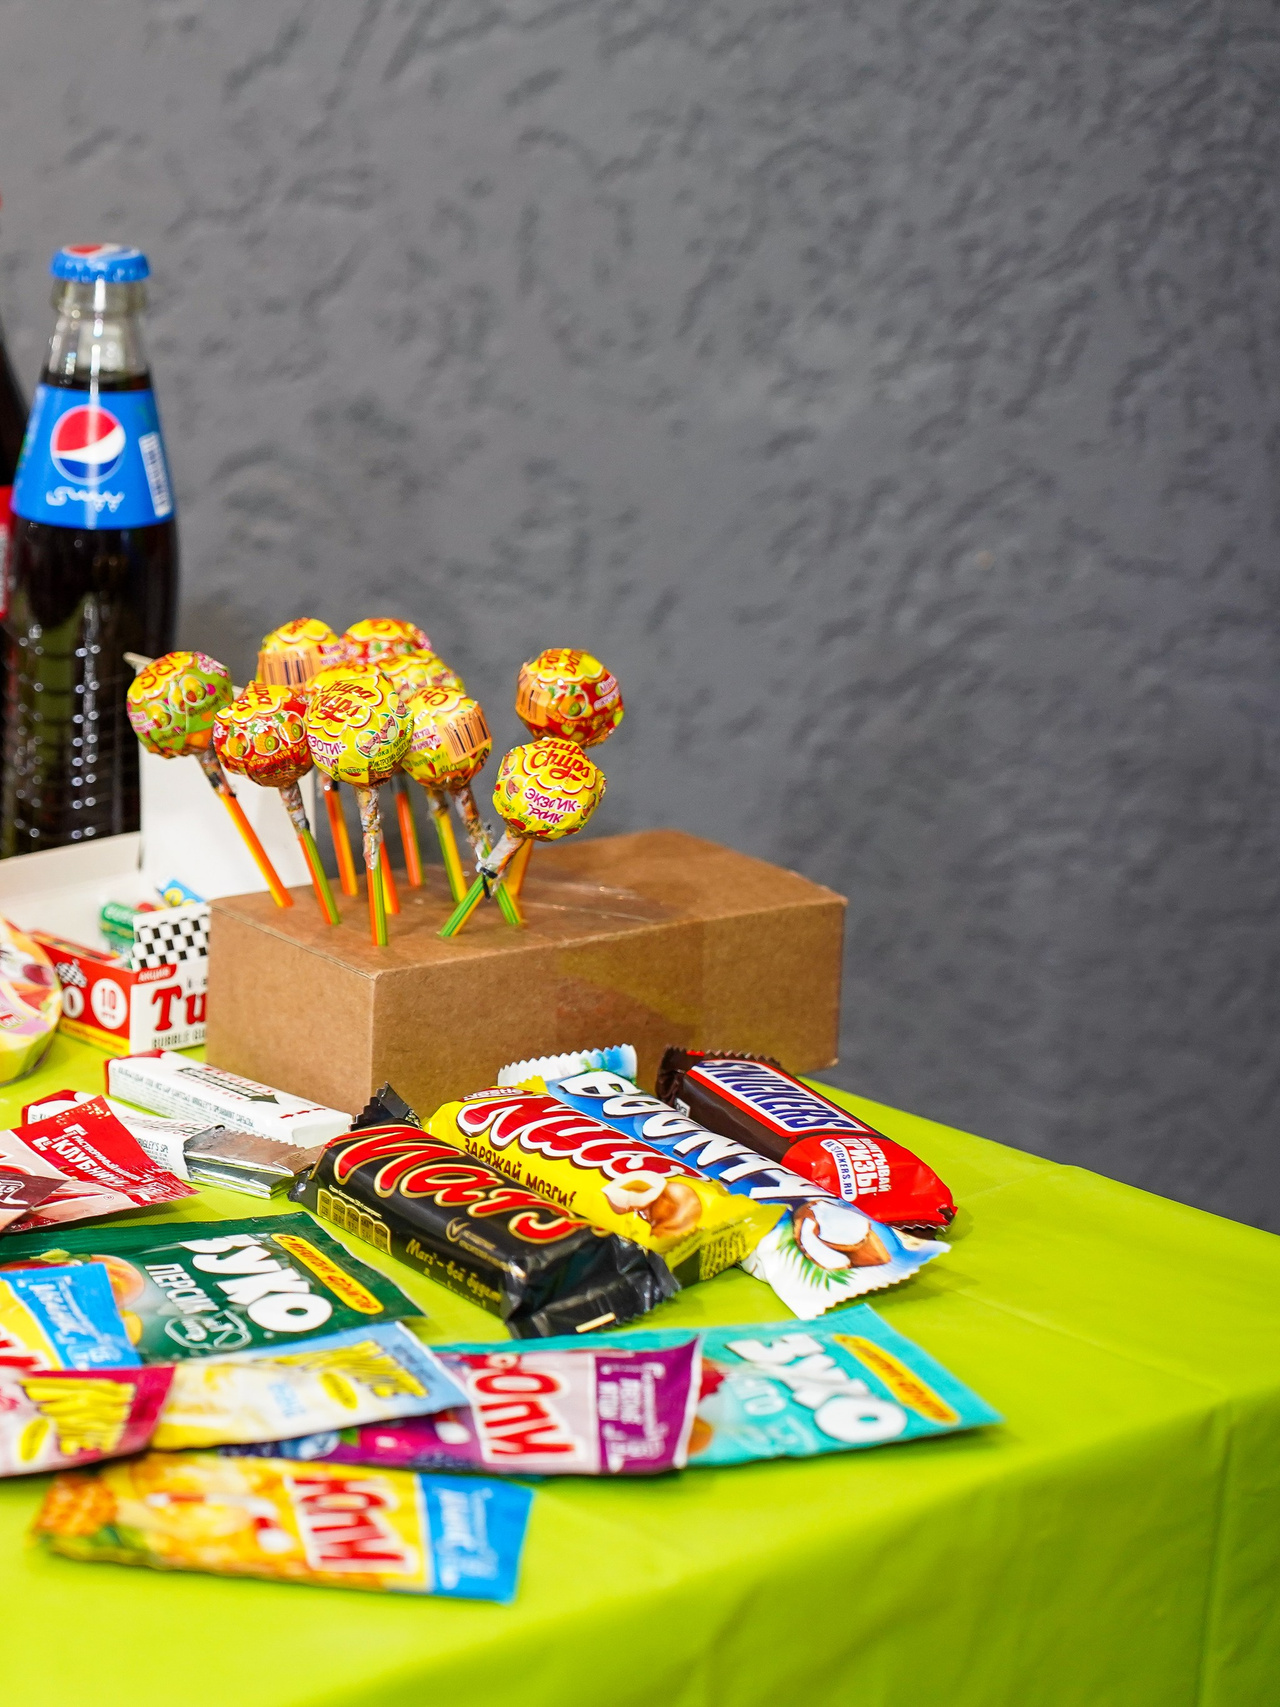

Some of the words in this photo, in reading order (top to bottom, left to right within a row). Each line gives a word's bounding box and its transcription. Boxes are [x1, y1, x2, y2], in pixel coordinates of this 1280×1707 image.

[530, 750, 590, 780] Chups
[100, 988, 117, 1010] 10
[152, 985, 207, 1032] Tu
[693, 1061, 858, 1129] SNICKERS
[456, 1094, 712, 1182] Nuts
[464, 1137, 522, 1181] ЗАРЯЖАЙ
[558, 1070, 836, 1200] BOUNTY
[310, 1124, 610, 1245] Mars
[831, 1145, 853, 1196] SICKERS.RU
[145, 1263, 220, 1315] ПЕРСИК
